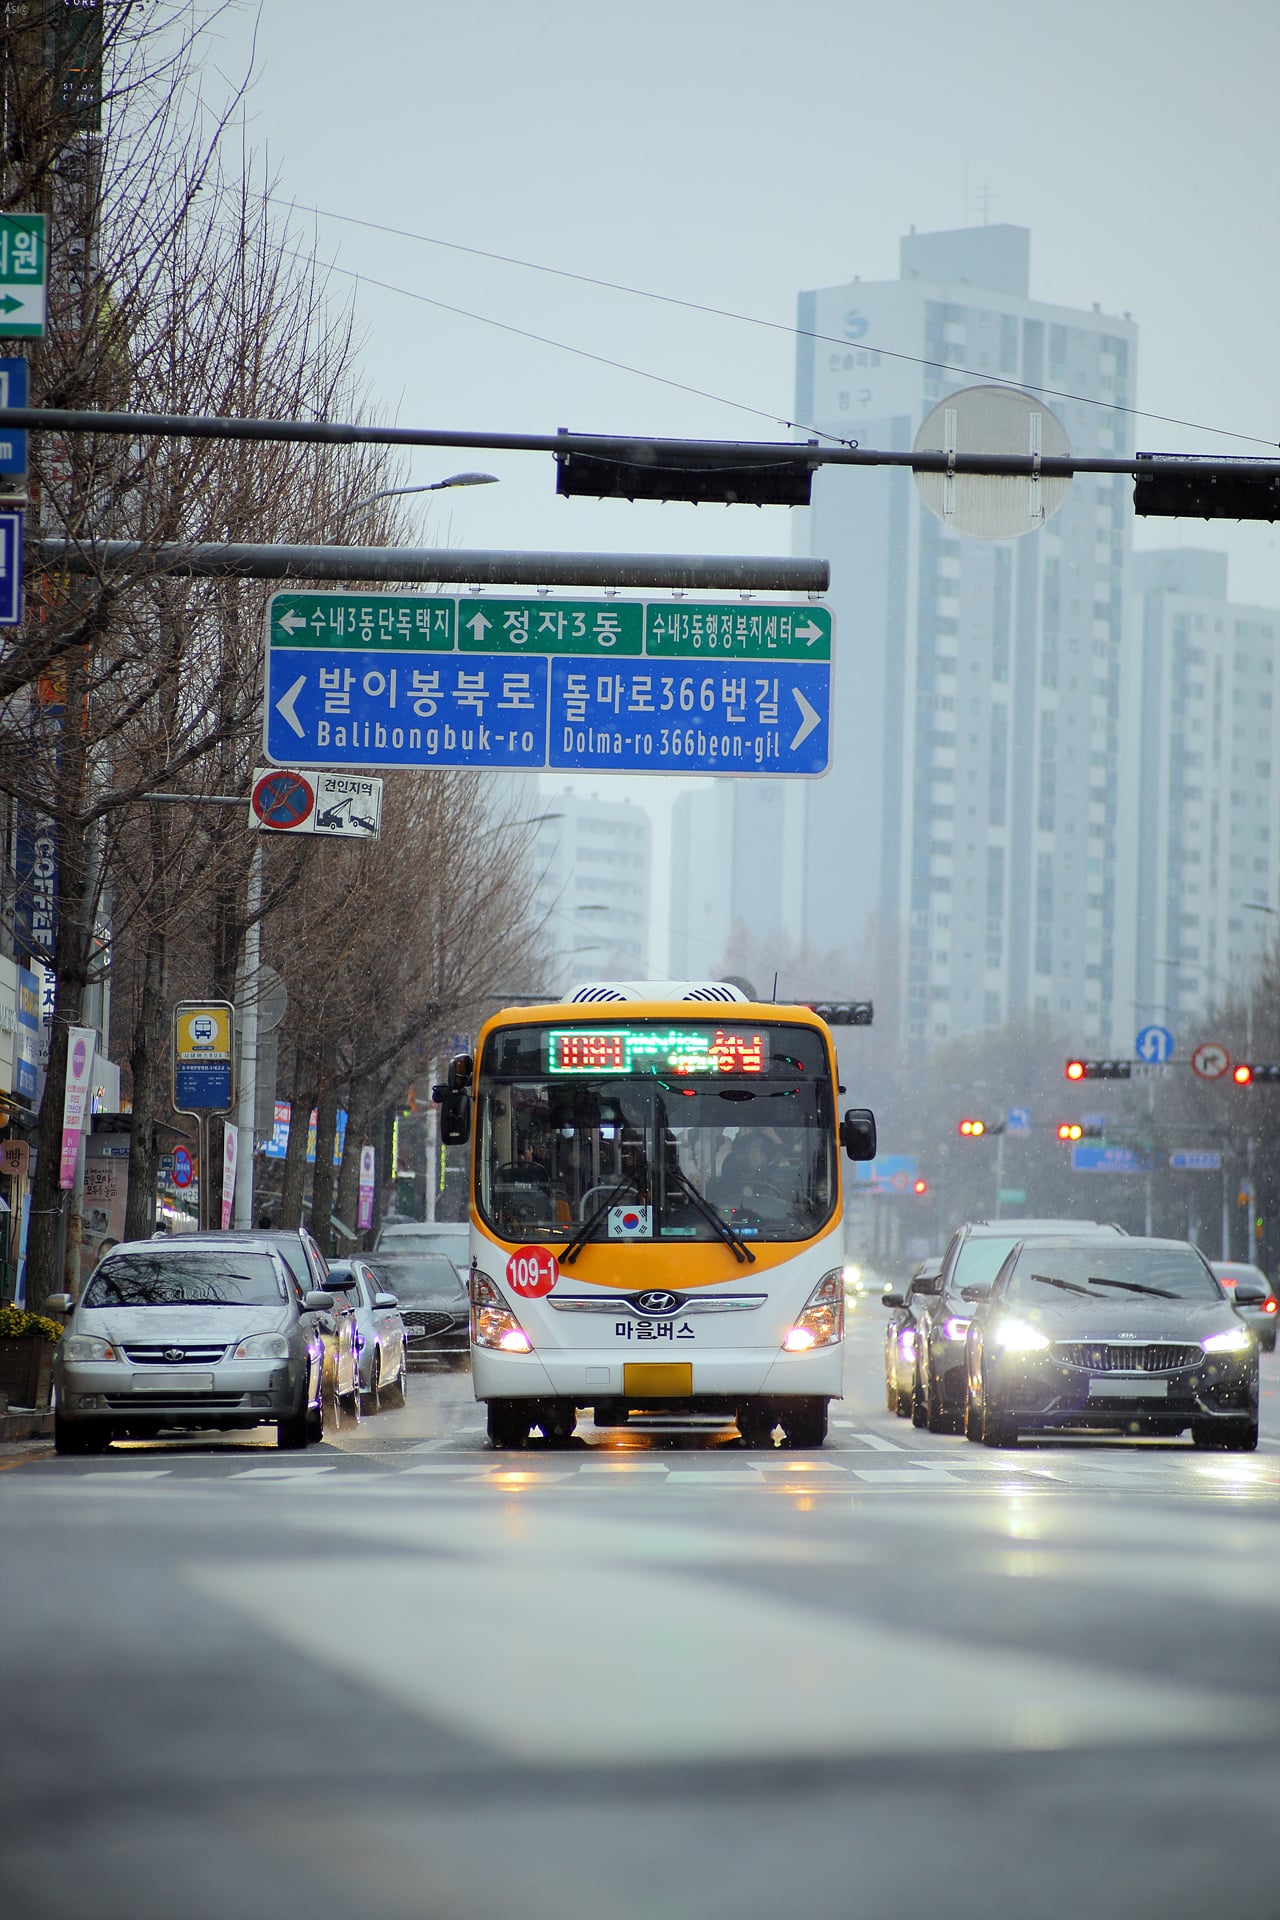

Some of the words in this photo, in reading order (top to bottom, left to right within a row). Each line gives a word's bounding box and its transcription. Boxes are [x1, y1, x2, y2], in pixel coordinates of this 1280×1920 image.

[310, 606, 449, 642] 수내3동단독택지
[502, 610, 622, 647] 정자3동
[652, 613, 792, 649] 수내3동행정복지센터
[319, 667, 535, 718] 발이봉북로
[562, 674, 779, 724] 돌마로366번길
[317, 720, 535, 755] Balibongbuk-ro
[563, 726, 653, 755] Dolma-ro
[659, 728, 780, 763] 366beon-gil
[324, 779, 373, 796] 견인지역
[5, 1148, 24, 1168] 빵
[509, 1256, 556, 1288] 109-1
[615, 1320, 695, 1340] 마을버스
